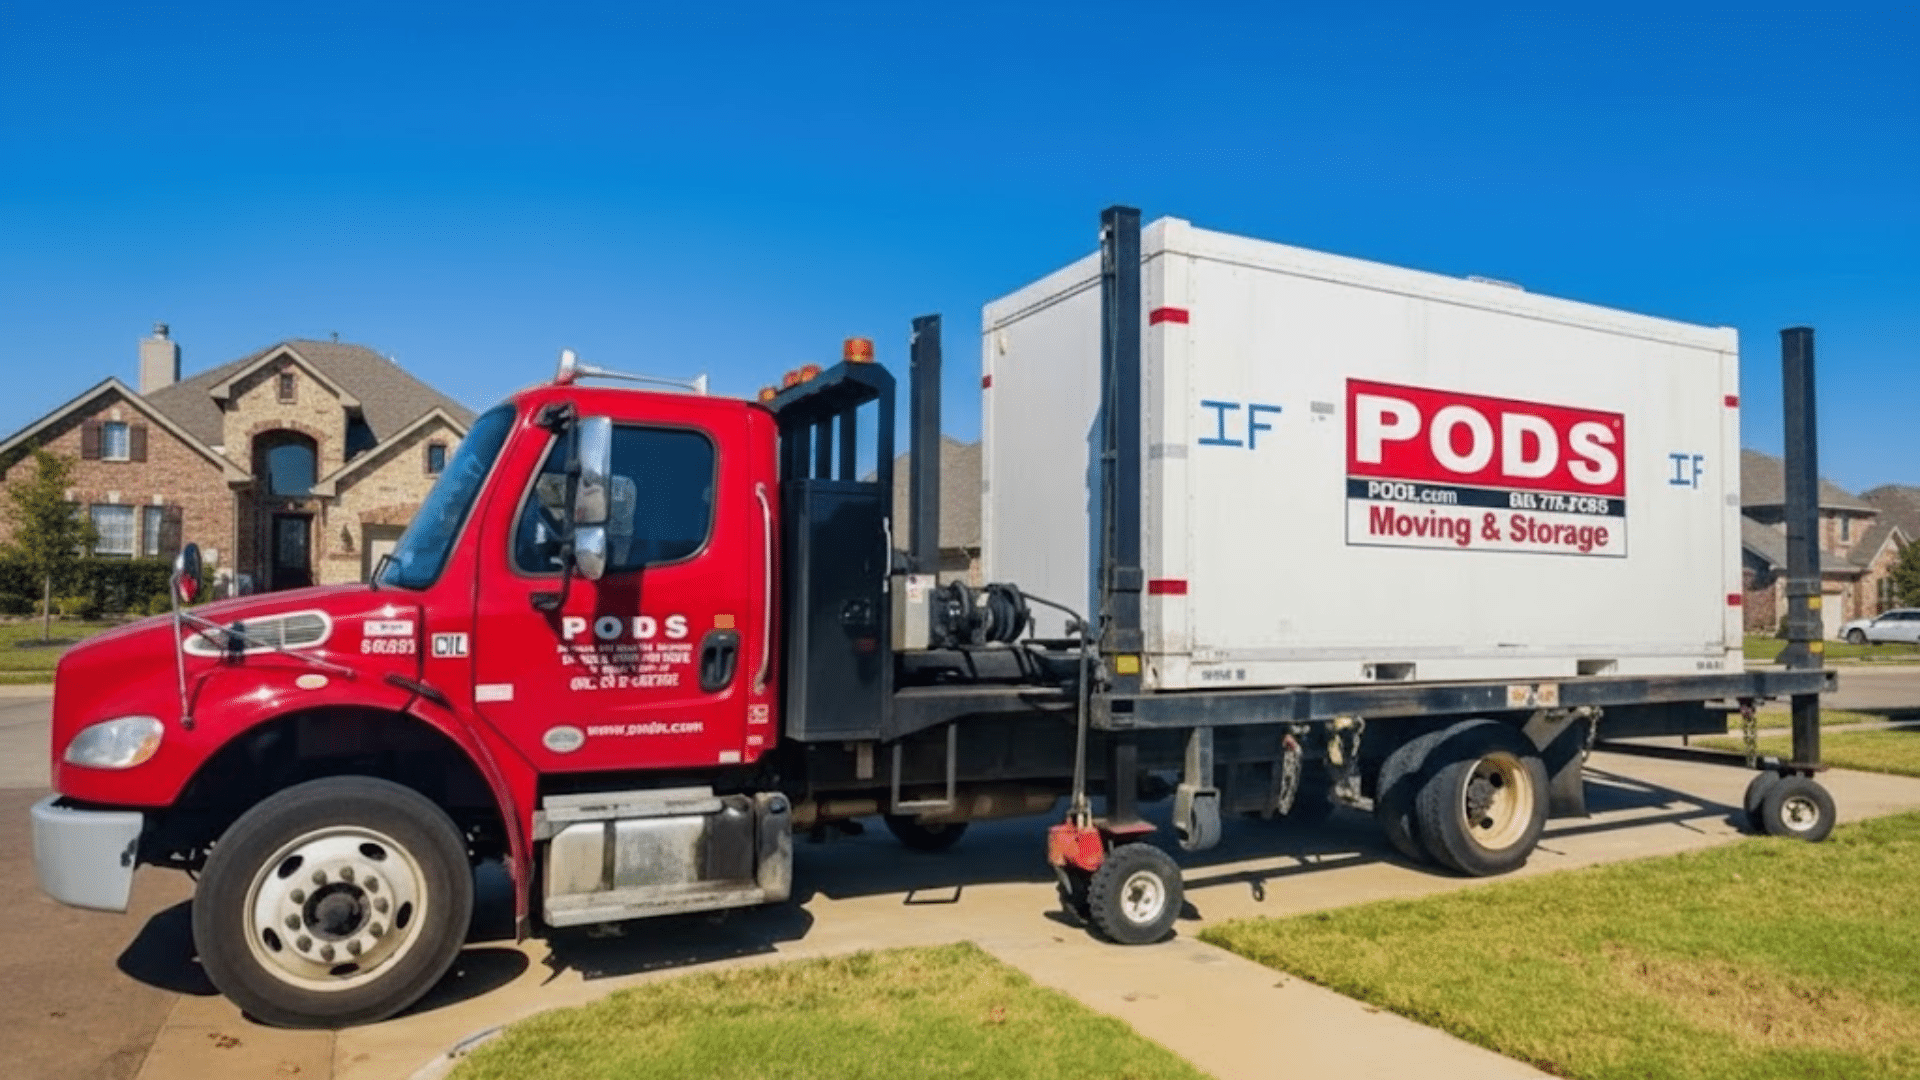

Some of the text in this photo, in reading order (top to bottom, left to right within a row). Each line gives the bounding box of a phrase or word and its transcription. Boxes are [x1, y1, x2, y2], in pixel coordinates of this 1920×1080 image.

[1198, 399, 1282, 450] IF
[1355, 393, 1619, 485] PODS
[1669, 453, 1704, 489] IF
[1370, 505, 1609, 553] Moving & Storage
[562, 614, 689, 640] PODS
